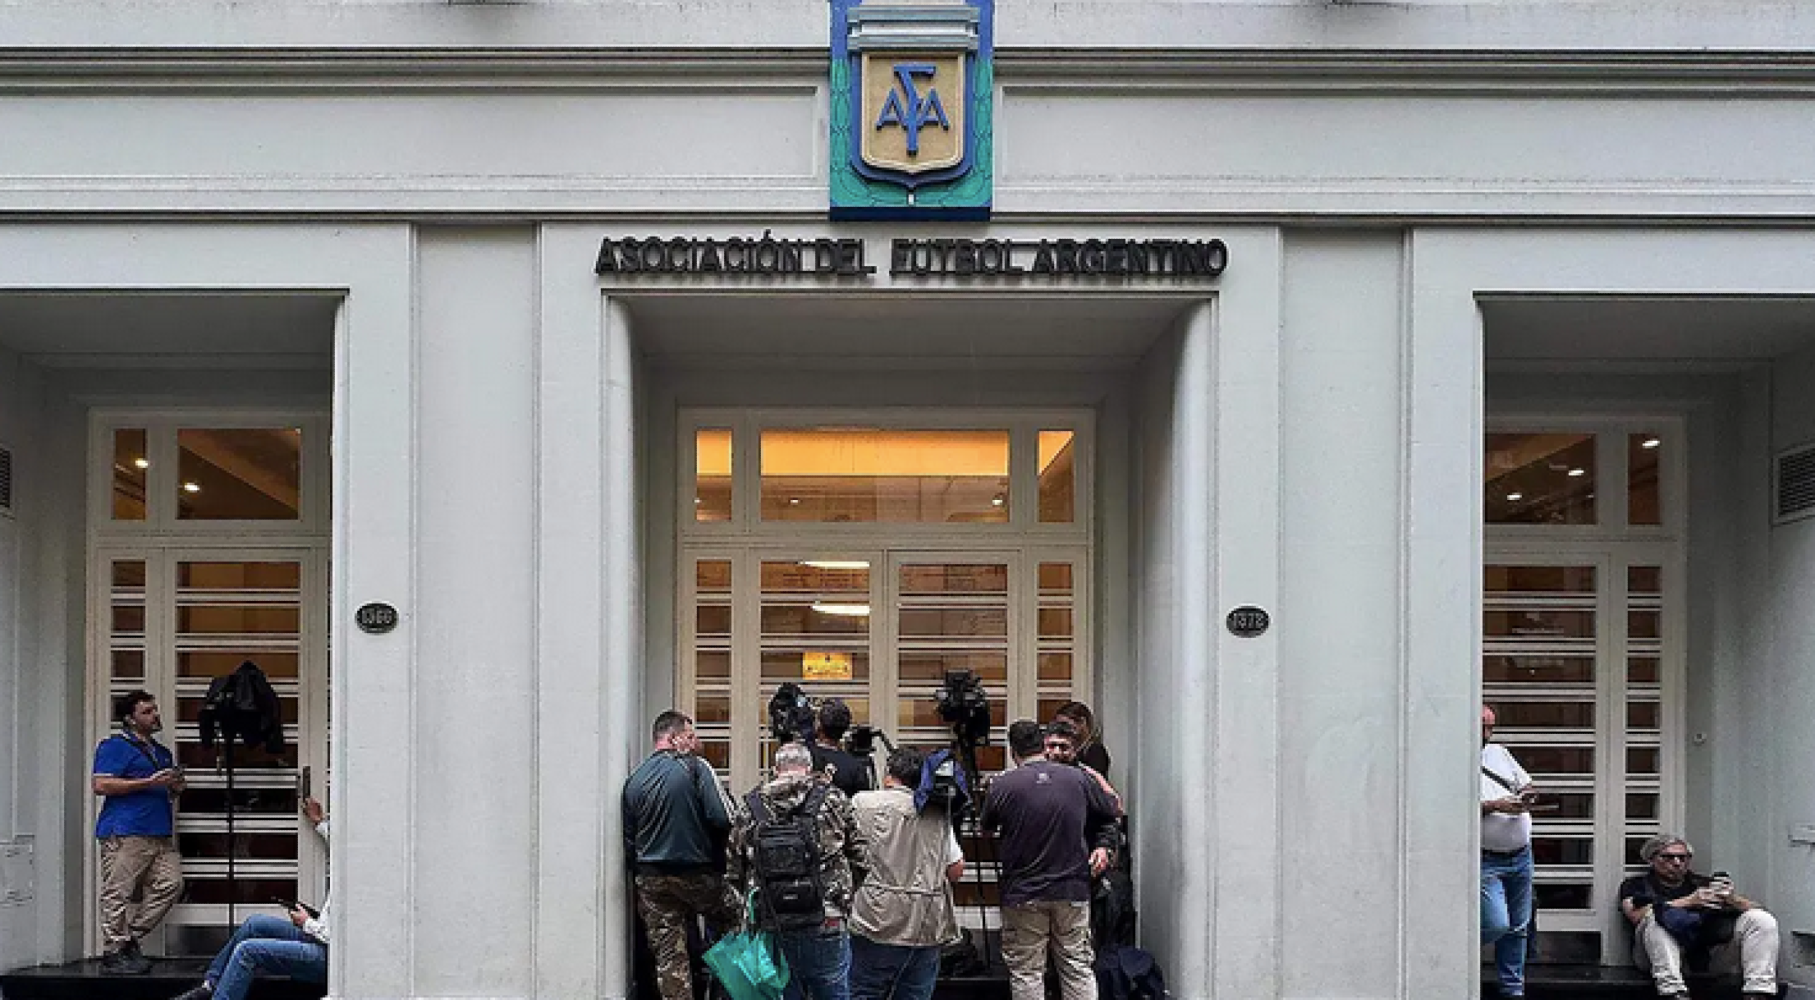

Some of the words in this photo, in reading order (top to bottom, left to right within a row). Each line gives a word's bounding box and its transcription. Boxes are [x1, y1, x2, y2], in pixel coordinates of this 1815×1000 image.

[594, 229, 802, 275] ASOCIACIÓN
[814, 238, 877, 276] DEL
[890, 238, 1025, 276] FUTBOL
[1031, 238, 1228, 276] ARGENTINO
